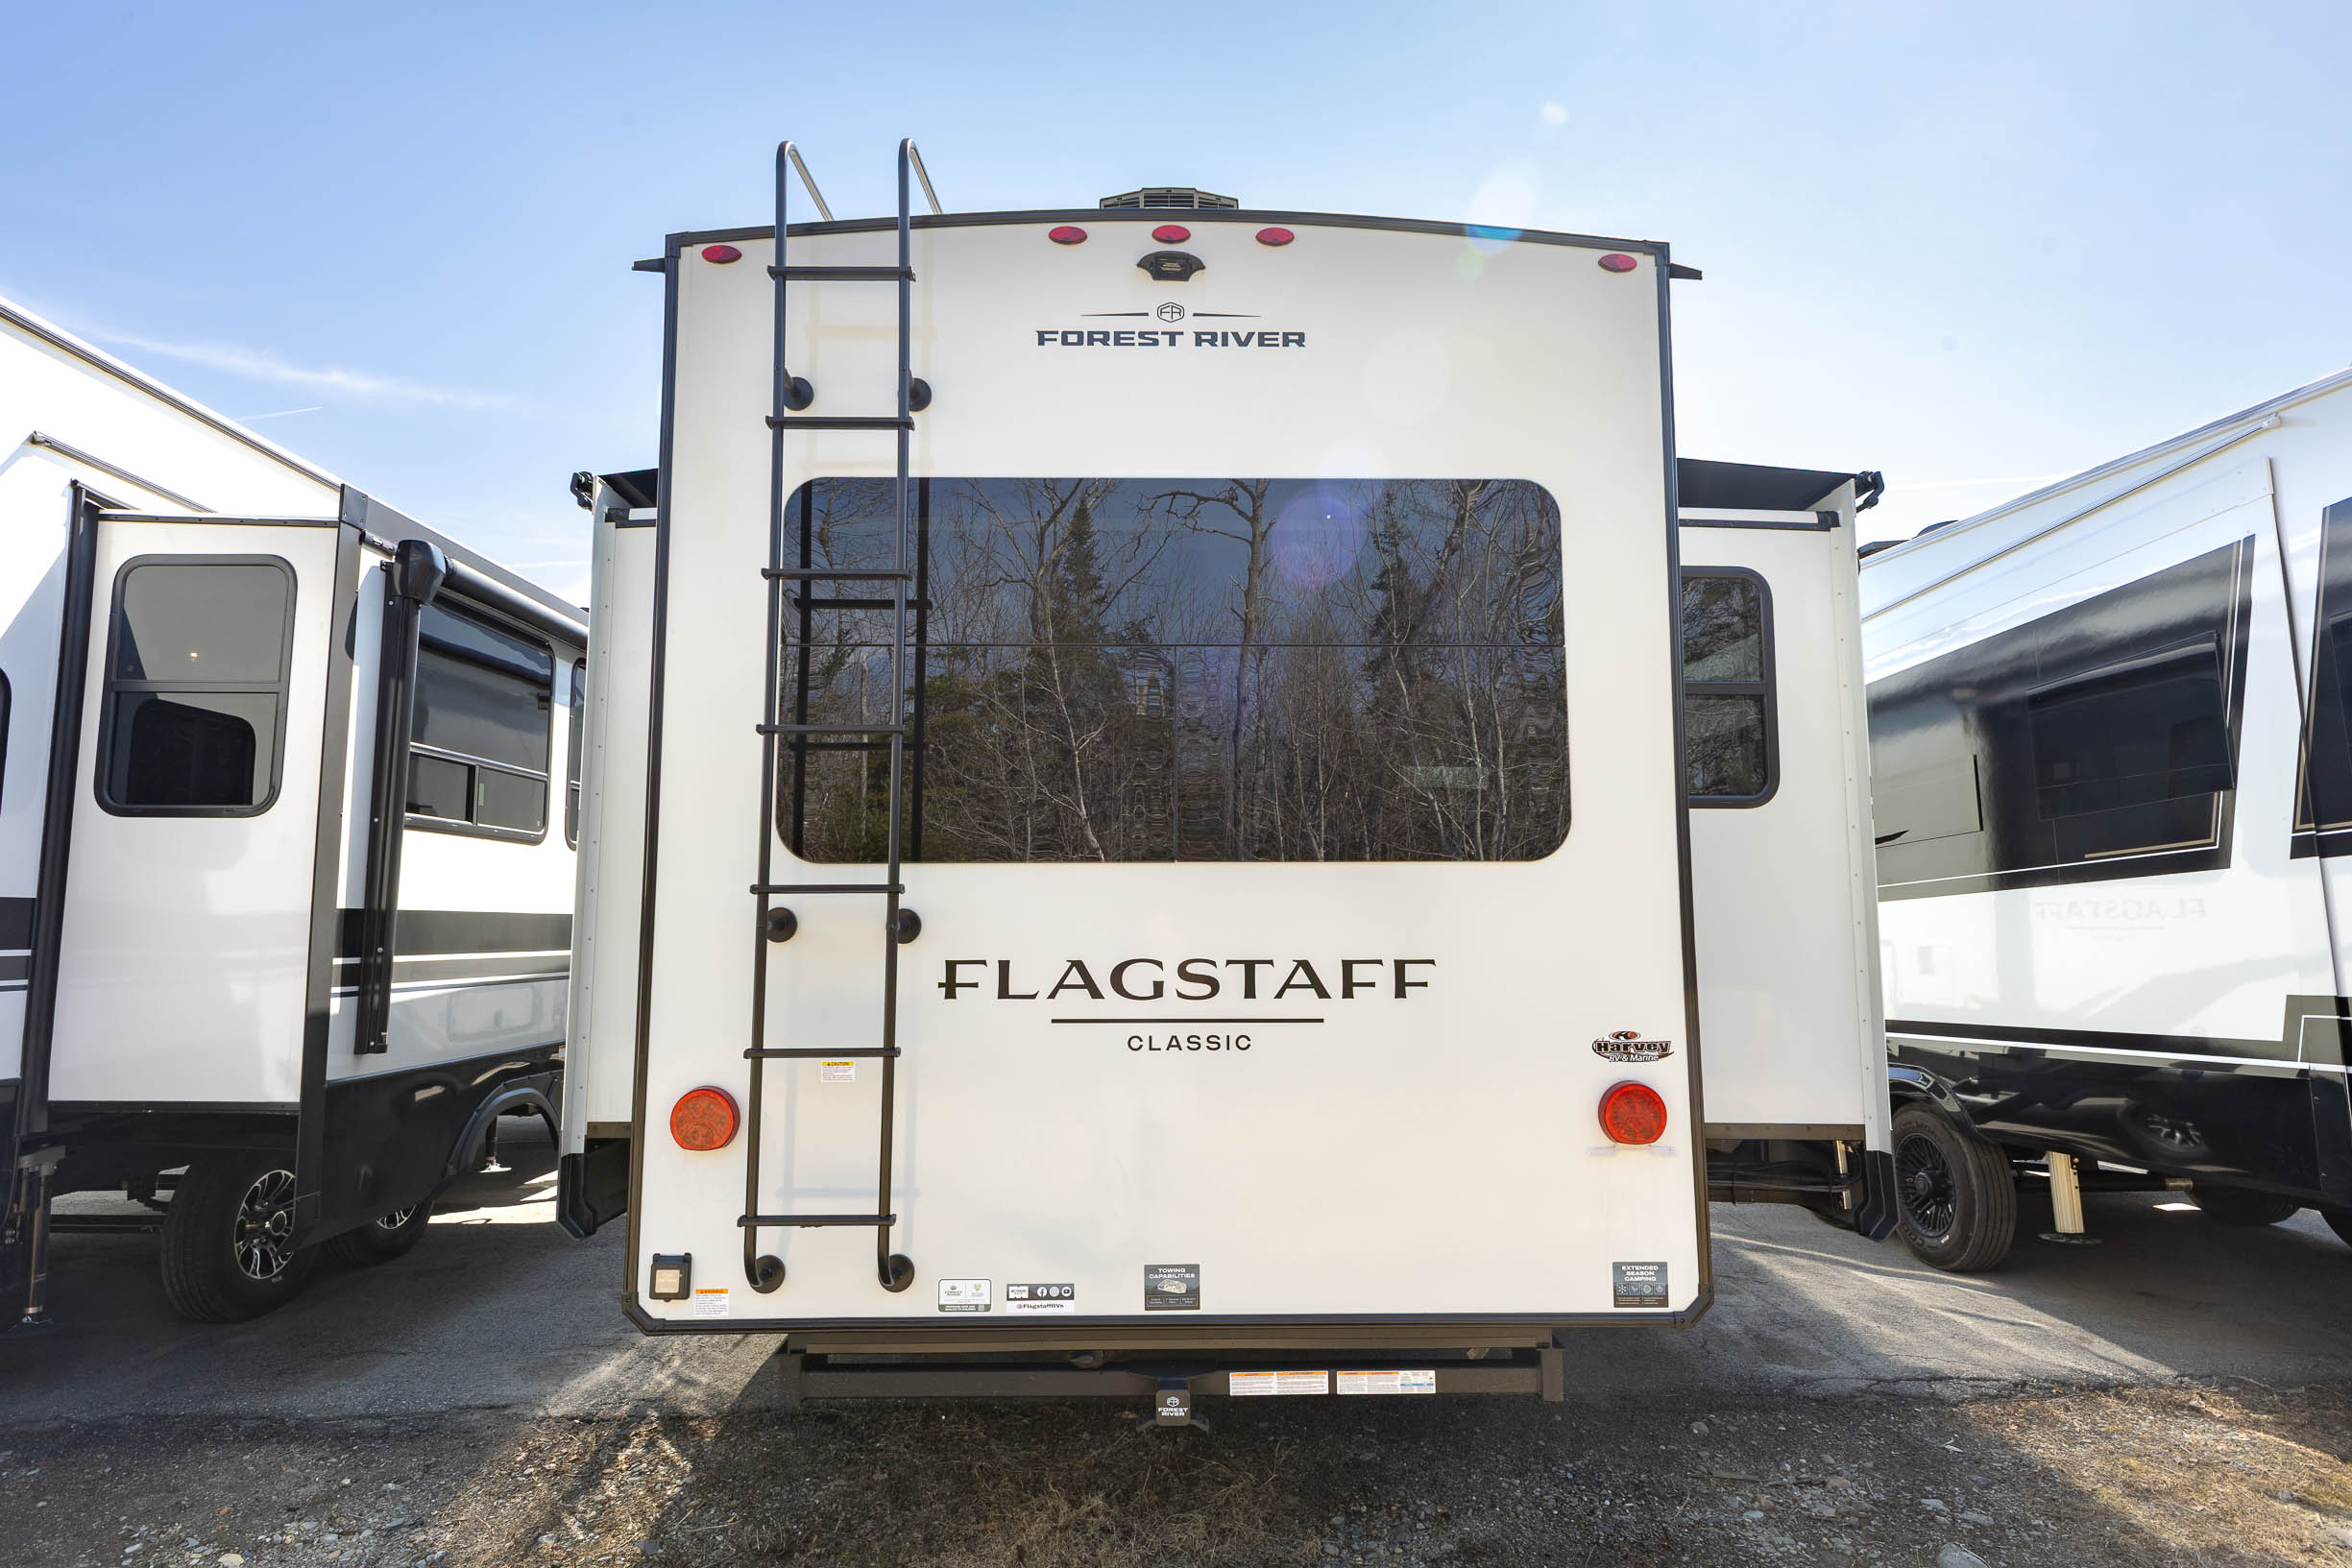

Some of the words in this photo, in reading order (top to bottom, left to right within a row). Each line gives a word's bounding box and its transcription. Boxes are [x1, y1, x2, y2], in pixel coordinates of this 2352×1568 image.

[1035, 329, 1184, 347] FOREST
[1193, 331, 1306, 348] RIVER
[937, 957, 1437, 1001] FLAGSTAFF
[1127, 1034, 1252, 1051] CLASSIC
[1594, 1041, 1671, 1053] Harvey
